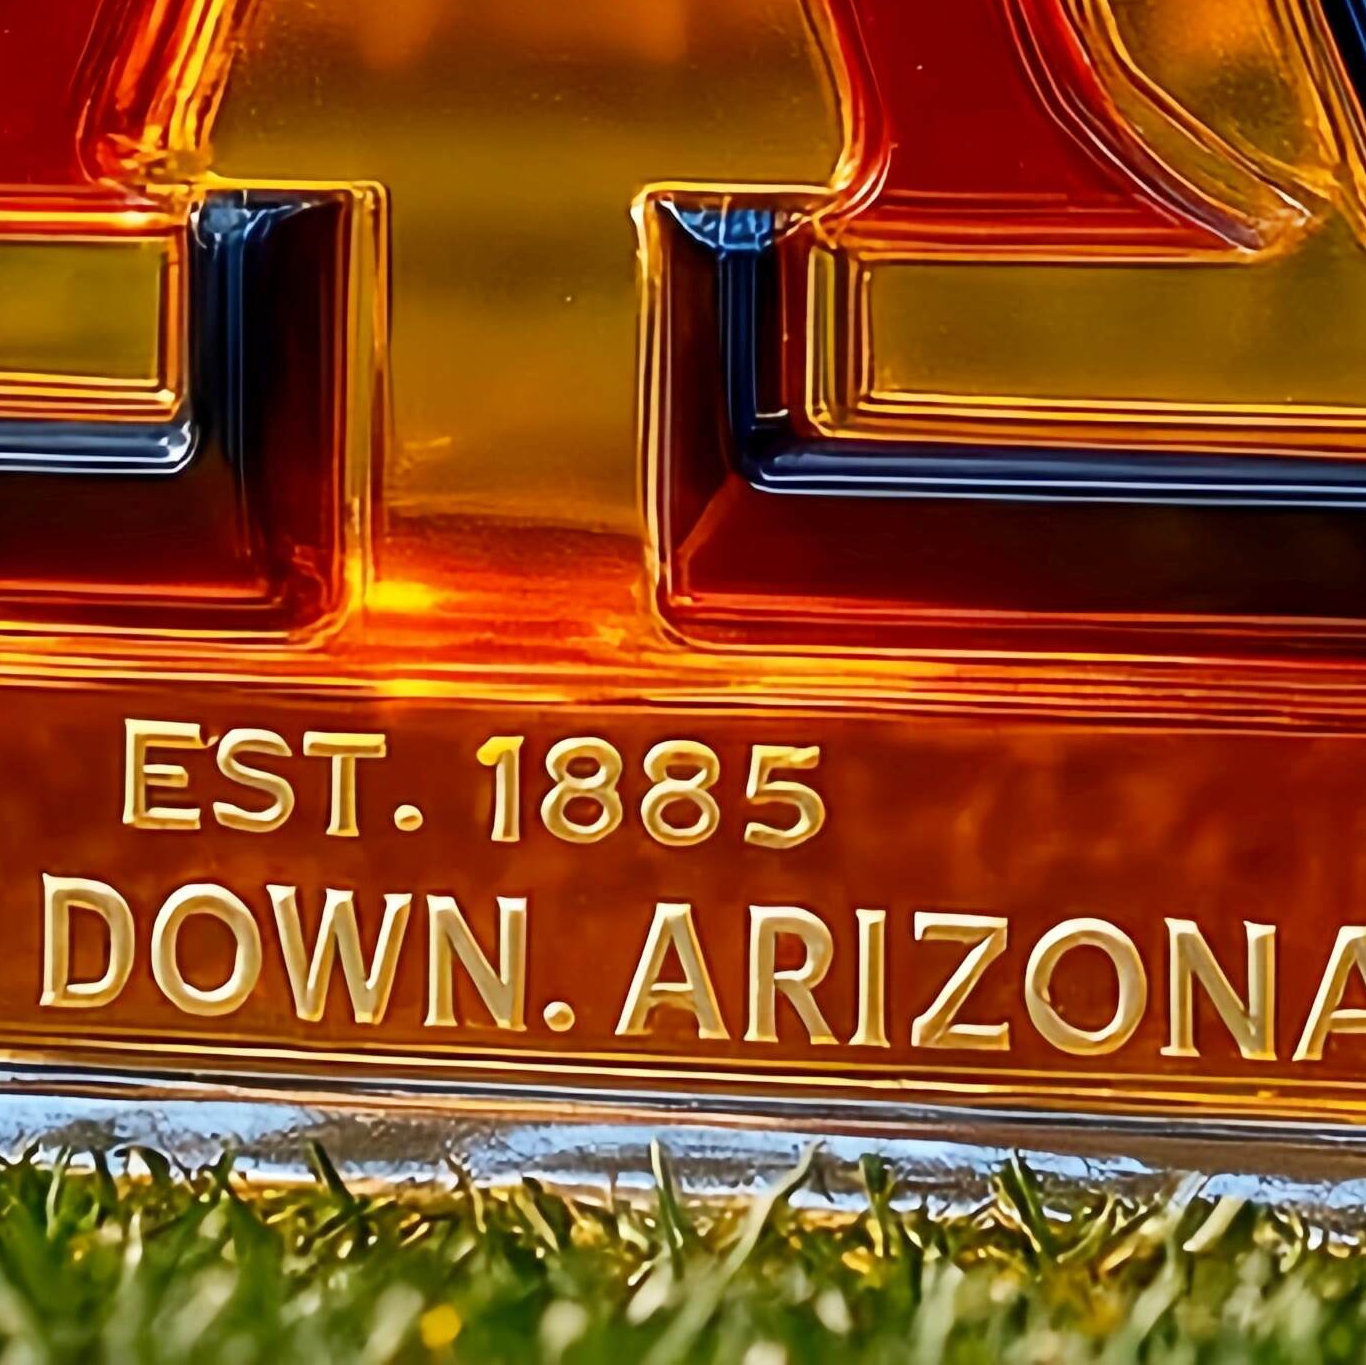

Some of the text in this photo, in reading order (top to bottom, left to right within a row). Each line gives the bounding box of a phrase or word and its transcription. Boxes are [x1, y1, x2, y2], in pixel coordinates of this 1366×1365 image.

[120, 718, 826, 848] EST. 1885
[40, 873, 576, 1032] DOWN.
